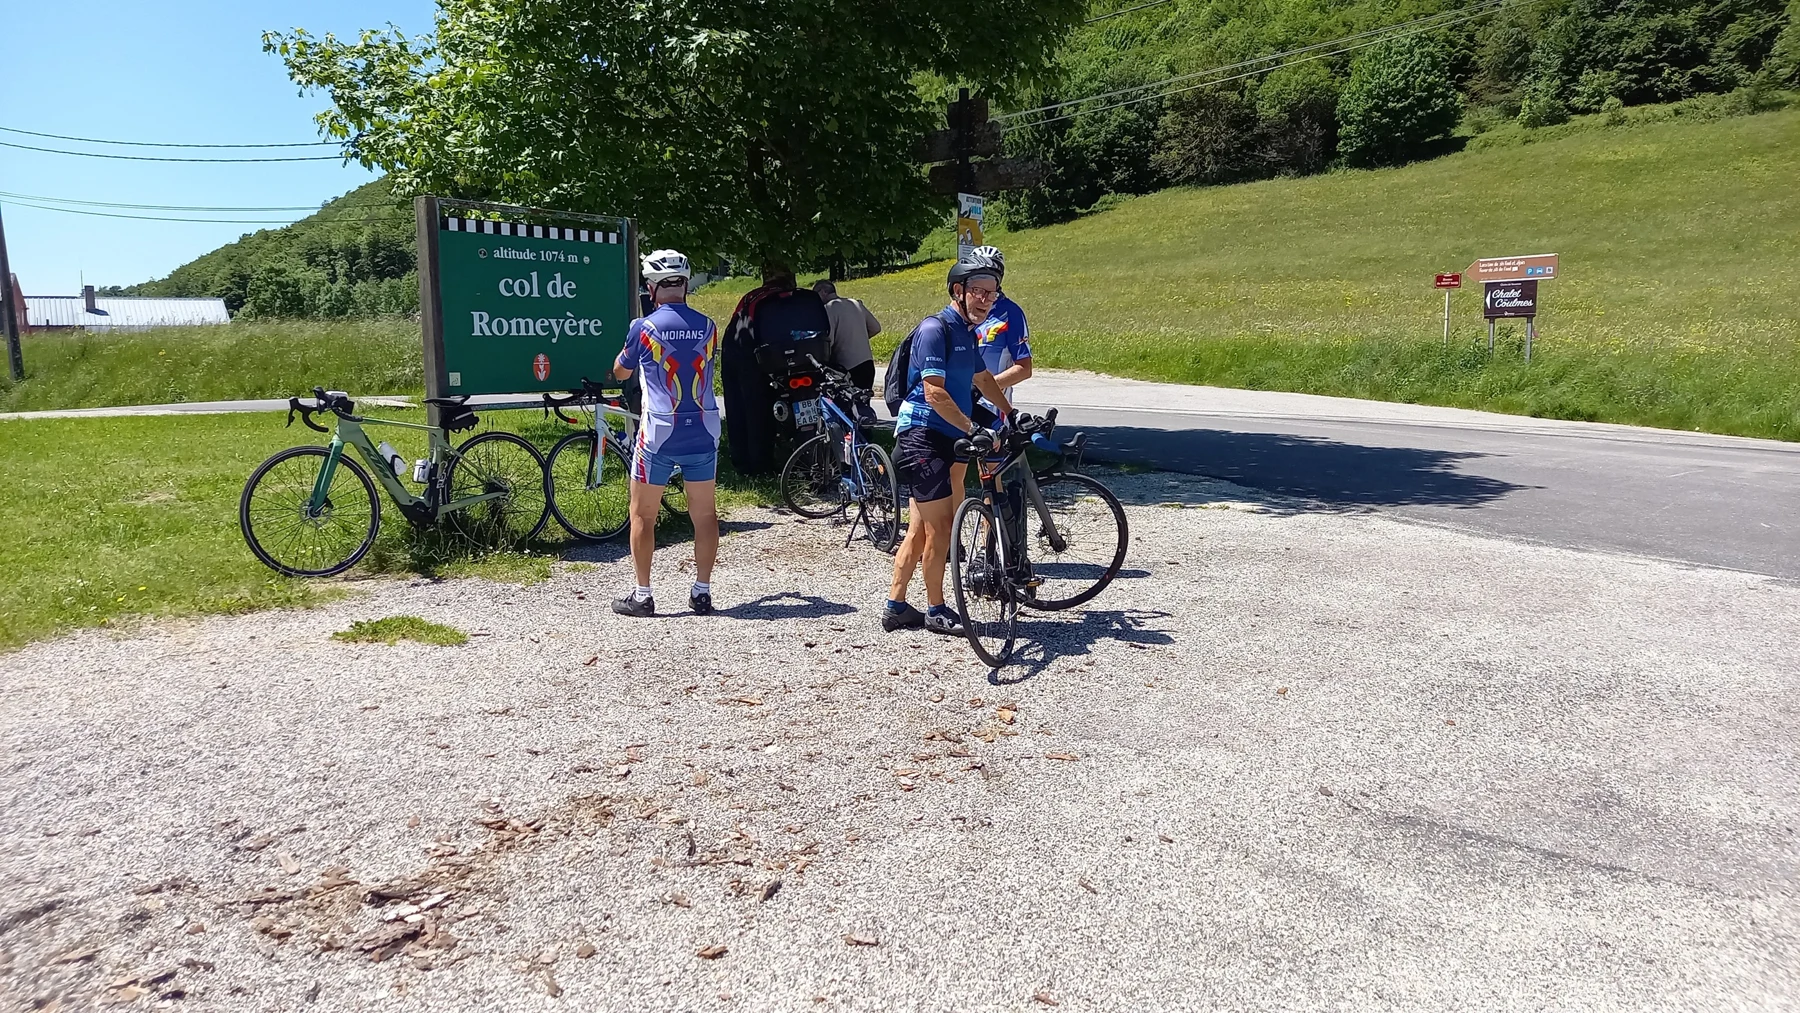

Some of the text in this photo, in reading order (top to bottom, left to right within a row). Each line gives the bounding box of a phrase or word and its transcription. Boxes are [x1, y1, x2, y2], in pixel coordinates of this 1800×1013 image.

[493, 247, 579, 263] altitude 1074 m
[499, 271, 577, 298] col de
[1492, 289, 1522, 298] Chalet
[1495, 298, 1534, 308] Coulmes
[470, 311, 602, 343] Romeyère
[661, 330, 704, 341] MOIRANS
